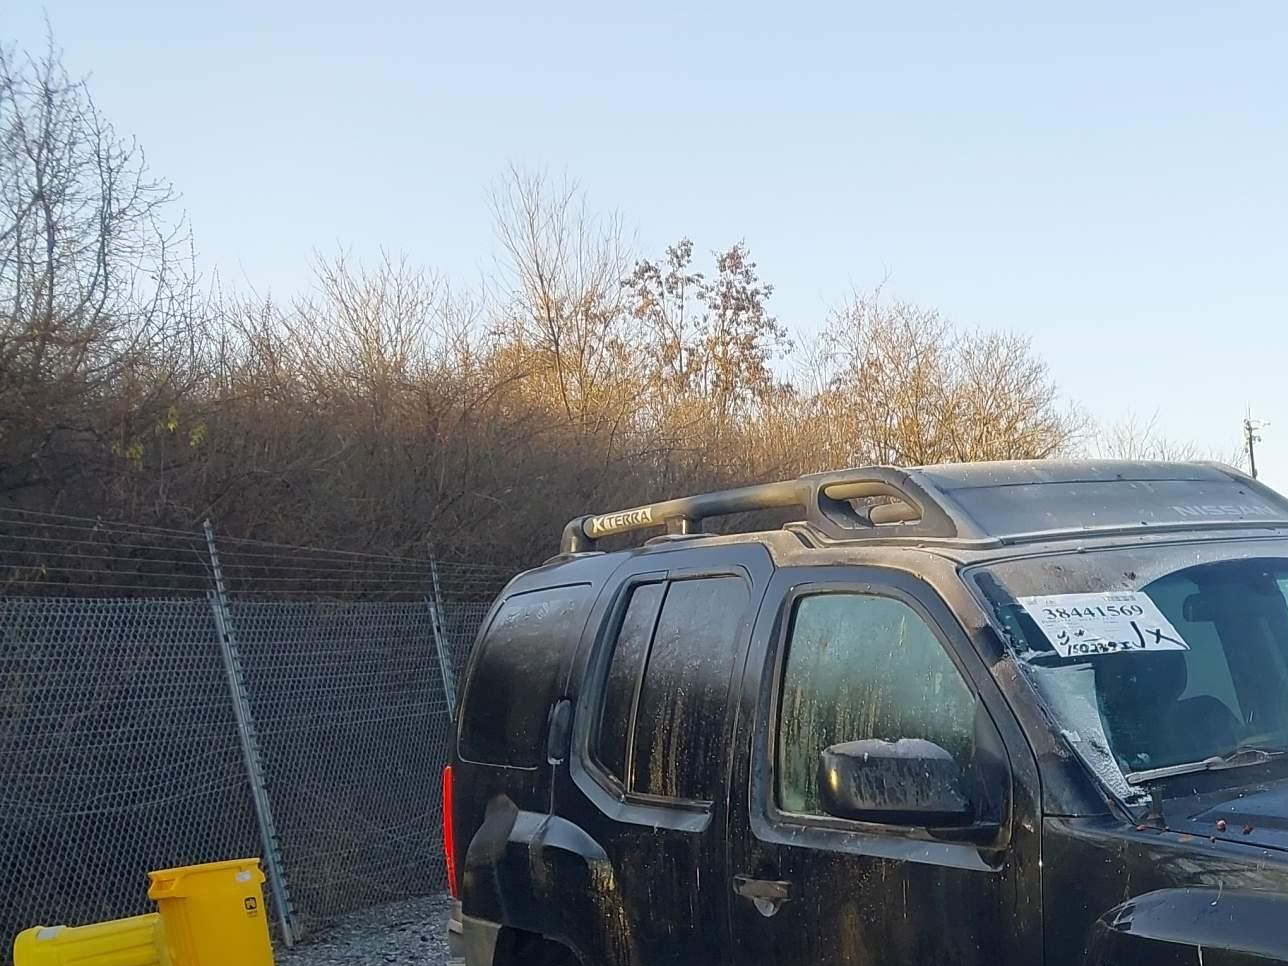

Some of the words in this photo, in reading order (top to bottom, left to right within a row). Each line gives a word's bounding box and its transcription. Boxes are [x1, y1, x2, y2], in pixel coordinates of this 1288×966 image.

[1171, 504, 1277, 517] NISSAN
[592, 508, 653, 534] XTERRA
[1041, 604, 1145, 620] 38441569
